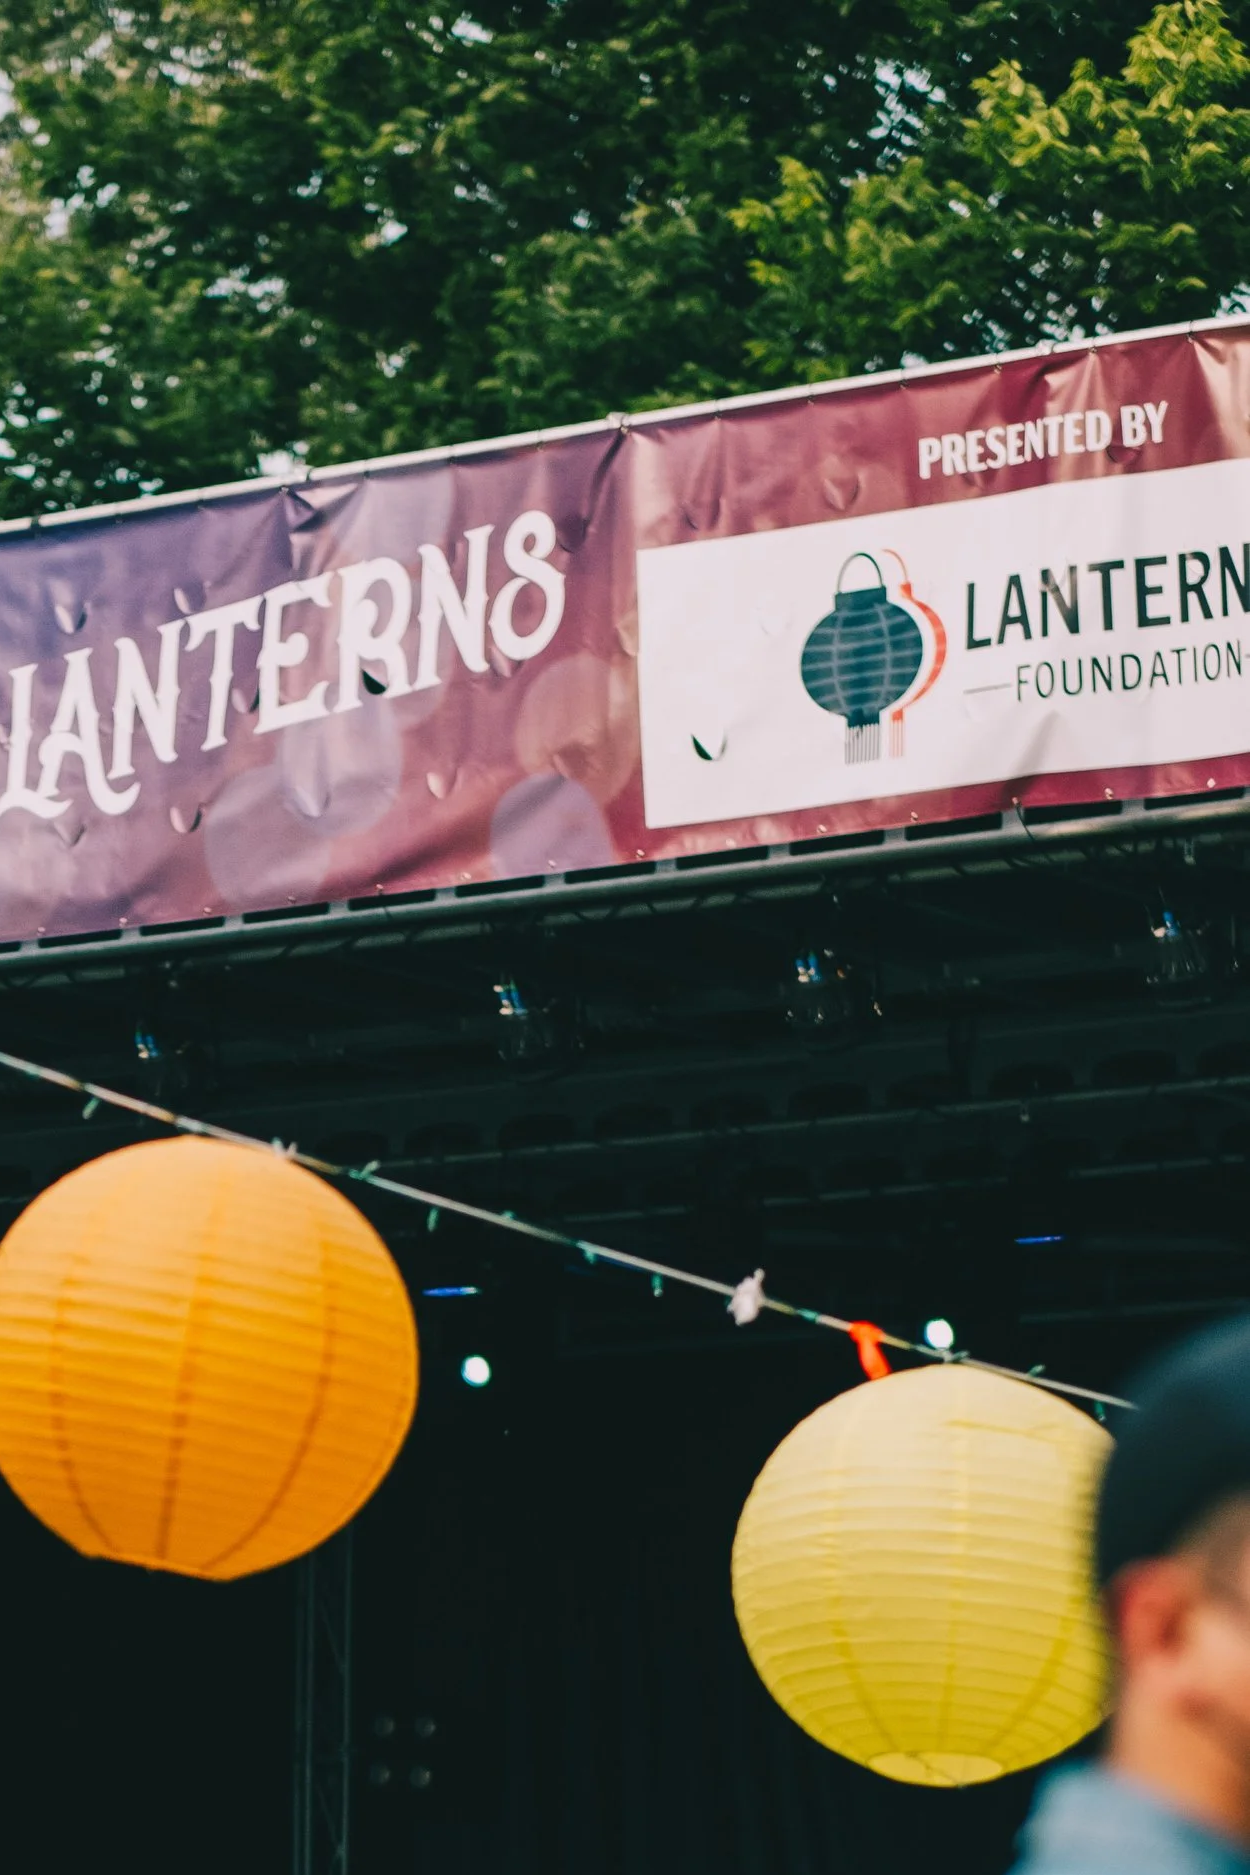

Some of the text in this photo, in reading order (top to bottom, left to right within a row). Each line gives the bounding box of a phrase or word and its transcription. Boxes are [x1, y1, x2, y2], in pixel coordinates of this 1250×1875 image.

[918, 400, 1168, 479] PRESENTED BY
[965, 542, 1250, 650] LANTERN
[1016, 638, 1242, 702] FOUNDATION
